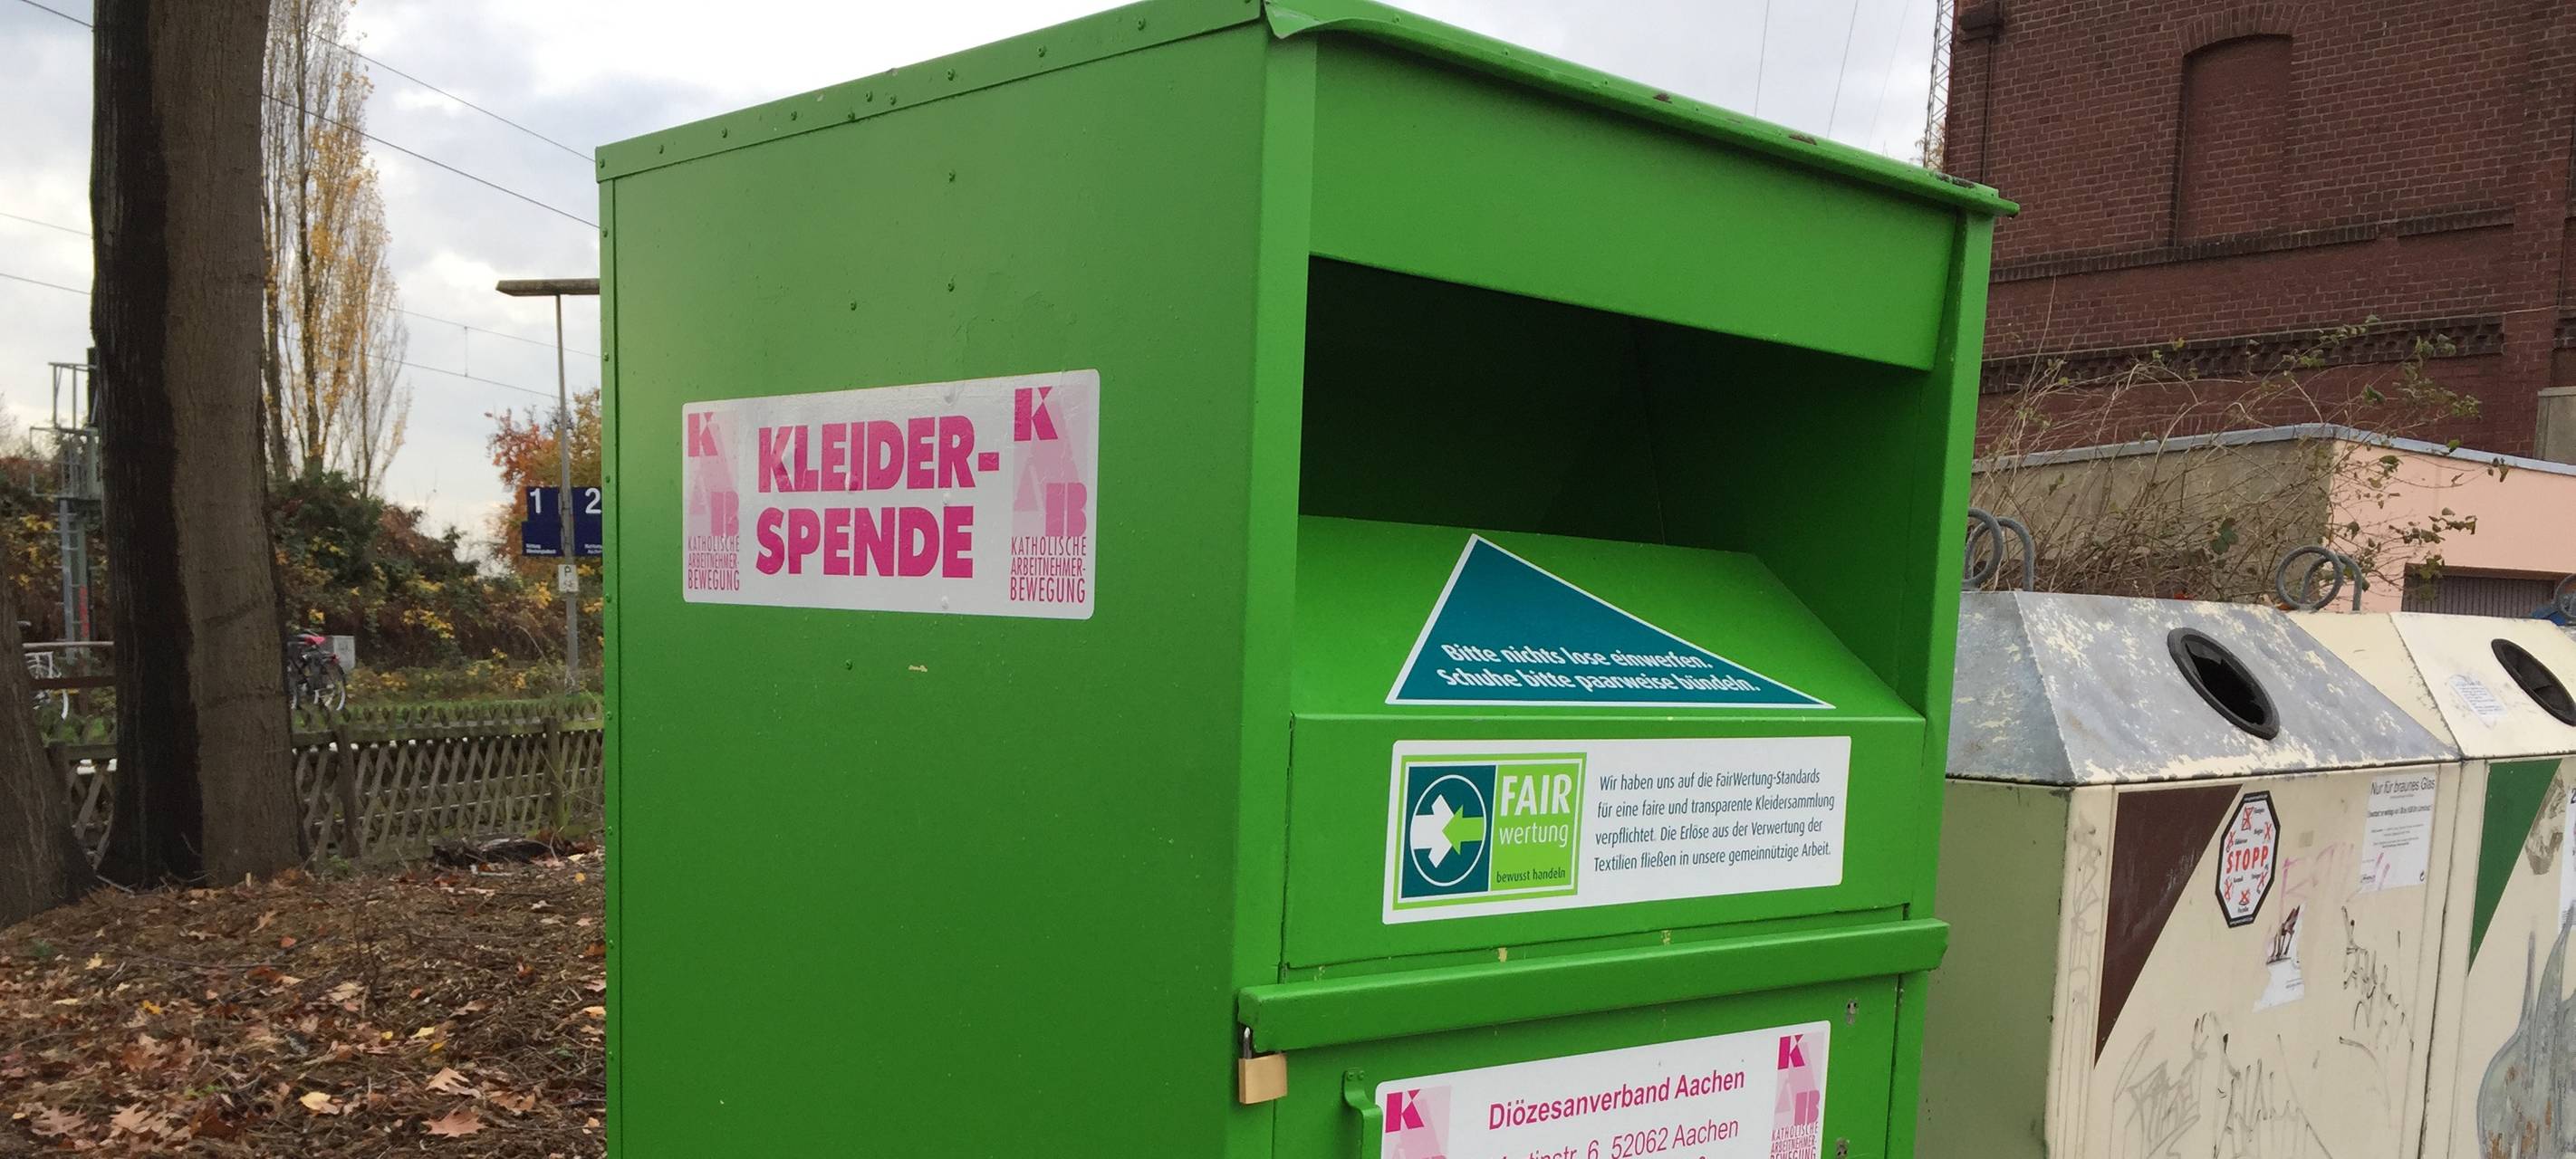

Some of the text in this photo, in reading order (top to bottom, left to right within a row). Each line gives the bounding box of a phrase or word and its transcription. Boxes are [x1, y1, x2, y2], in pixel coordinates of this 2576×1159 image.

[758, 415, 1000, 493] KLEIDER-
[529, 487, 542, 514] 1
[584, 487, 602, 514] 2
[688, 536, 740, 553] KATHOLISCHE
[755, 505, 974, 579] SPENDE
[1011, 536, 1087, 557] KATHOLISCHE
[688, 552, 740, 570] ARBEITNEHMER-
[1010, 557, 1086, 578] ARBEITNEHMER-
[688, 569, 740, 591] BEWEGUNG
[1010, 577, 1085, 604] BEWEGUNG
[1440, 644, 1714, 669] Bitte nichts lose einwerfen.
[1437, 667, 1762, 693] Schuhe bitte paarweise bündeln.
[1600, 768, 1821, 791] Wir haben uns auf die FairWertung-Standards
[2370, 776, 2436, 795] Nur für braunes Glas
[1500, 773, 1572, 817] FAIR
[1597, 792, 1835, 819] für eine faire und transparente Kleidersammlung
[1499, 822, 1569, 848] wertung
[1660, 825, 1677, 841] Die
[1680, 823, 1709, 840] Erlöse
[1712, 825, 1730, 838] aus
[1732, 820, 1749, 837] der
[1751, 820, 1805, 837] Verwertung
[1808, 817, 1823, 832] der
[1594, 840, 1831, 872] Textilien fließen in unsere gemeinnützige Arbeit.
[2225, 844, 2269, 875] STOPP
[1496, 867, 1566, 884] bewusst handeln
[1489, 1069, 1745, 1131] Diözesanverband Aachen
[1611, 1127, 1668, 1159] 52062
[1672, 1119, 1739, 1149] Aachen
[1771, 1121, 1819, 1141] KATHOLISCHE
